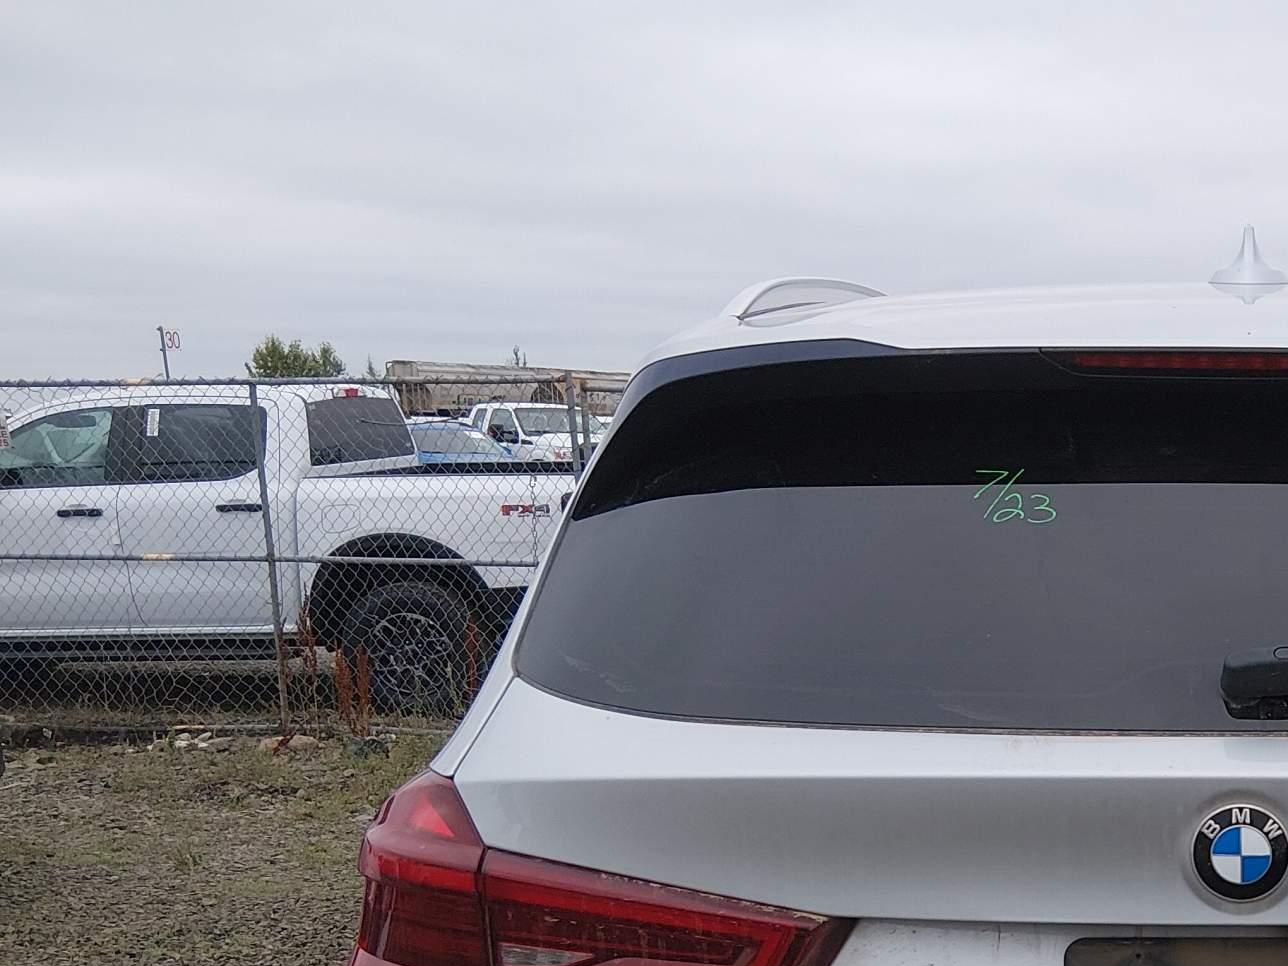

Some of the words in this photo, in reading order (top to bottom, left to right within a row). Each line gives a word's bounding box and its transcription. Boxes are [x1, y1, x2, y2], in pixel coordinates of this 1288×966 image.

[165, 331, 181, 349] 30
[973, 468, 1057, 523] 7/23
[501, 504, 550, 516] FX4
[1200, 808, 1283, 840] BMW
